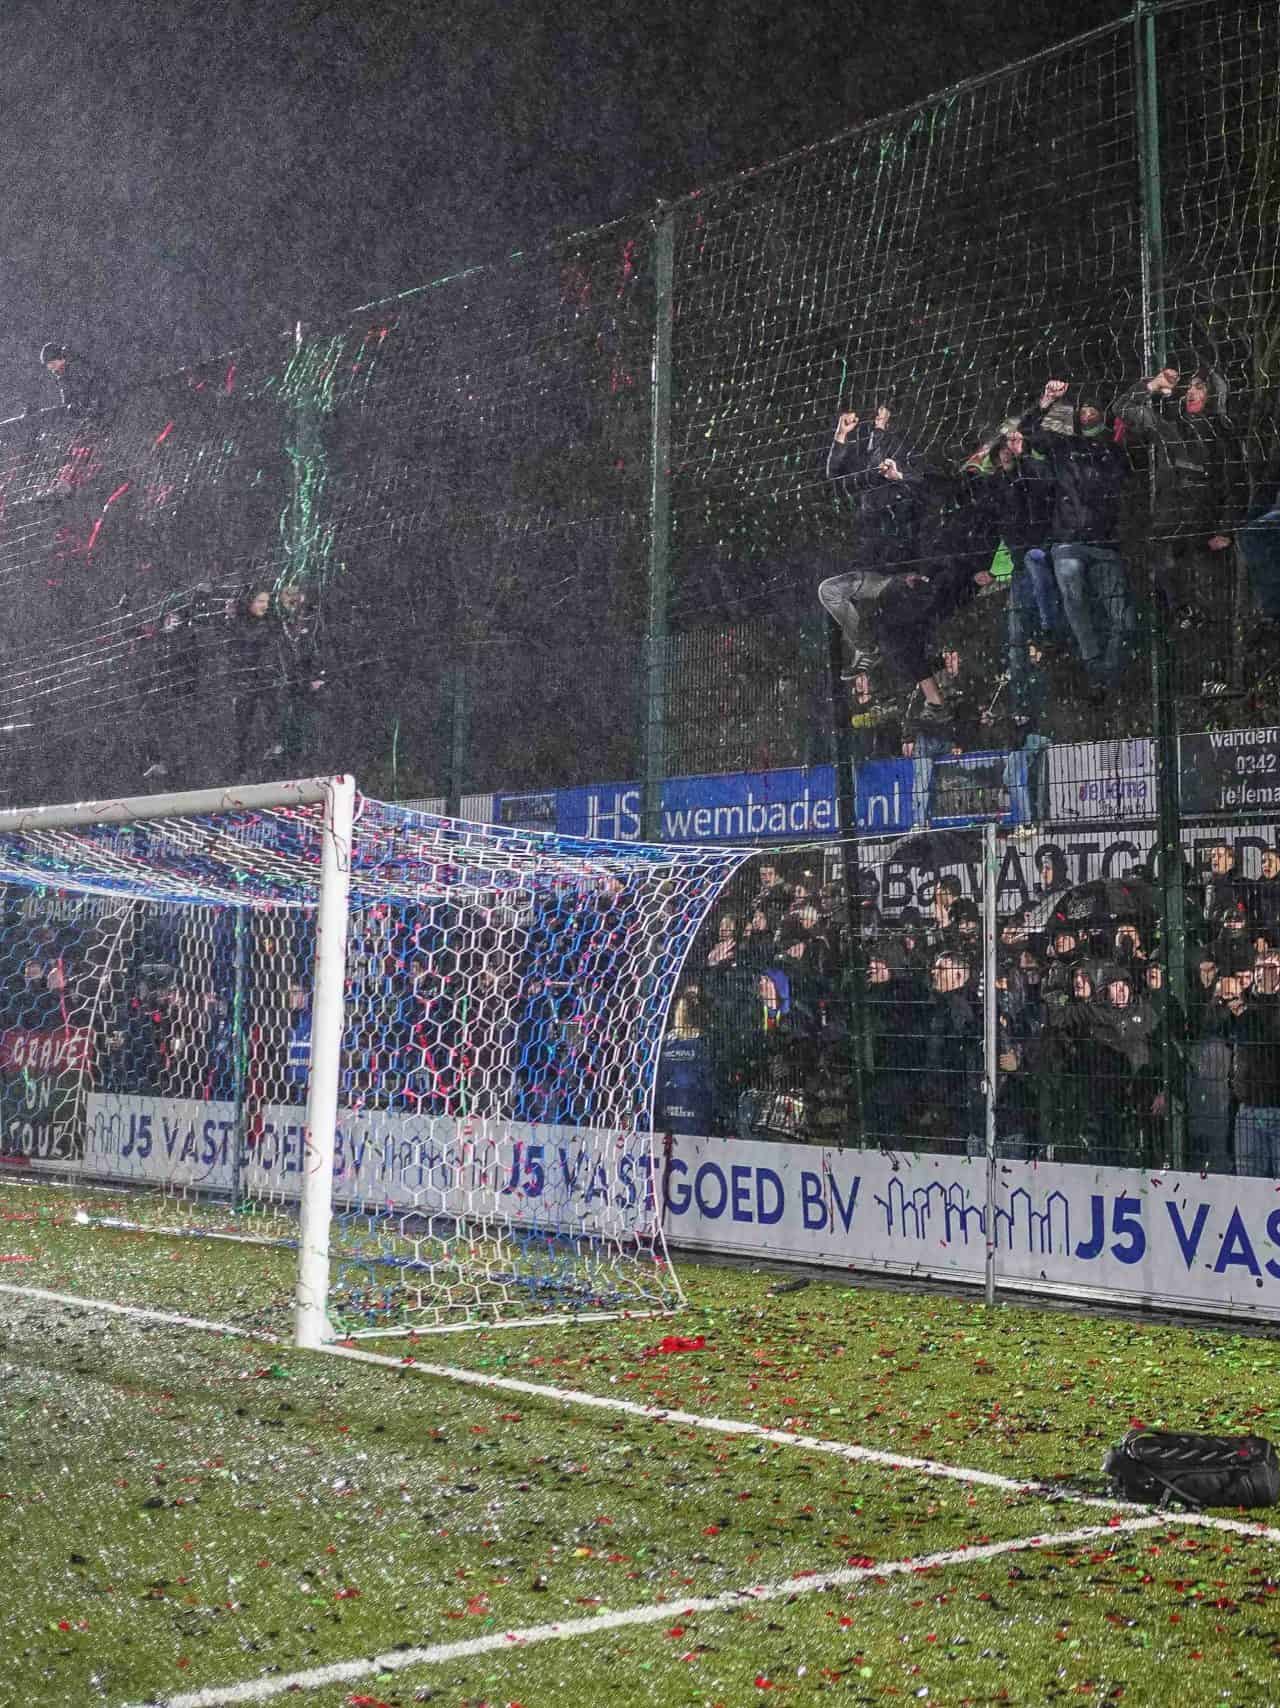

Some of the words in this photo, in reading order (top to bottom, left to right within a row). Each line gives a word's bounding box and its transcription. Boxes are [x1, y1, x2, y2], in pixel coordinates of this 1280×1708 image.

[122, 1112, 153, 1159] J5
[501, 1142, 545, 1198] J5
[558, 1146, 786, 1226] VASTGOED
[802, 1171, 861, 1234] BV
[1074, 1196, 1147, 1265] J5
